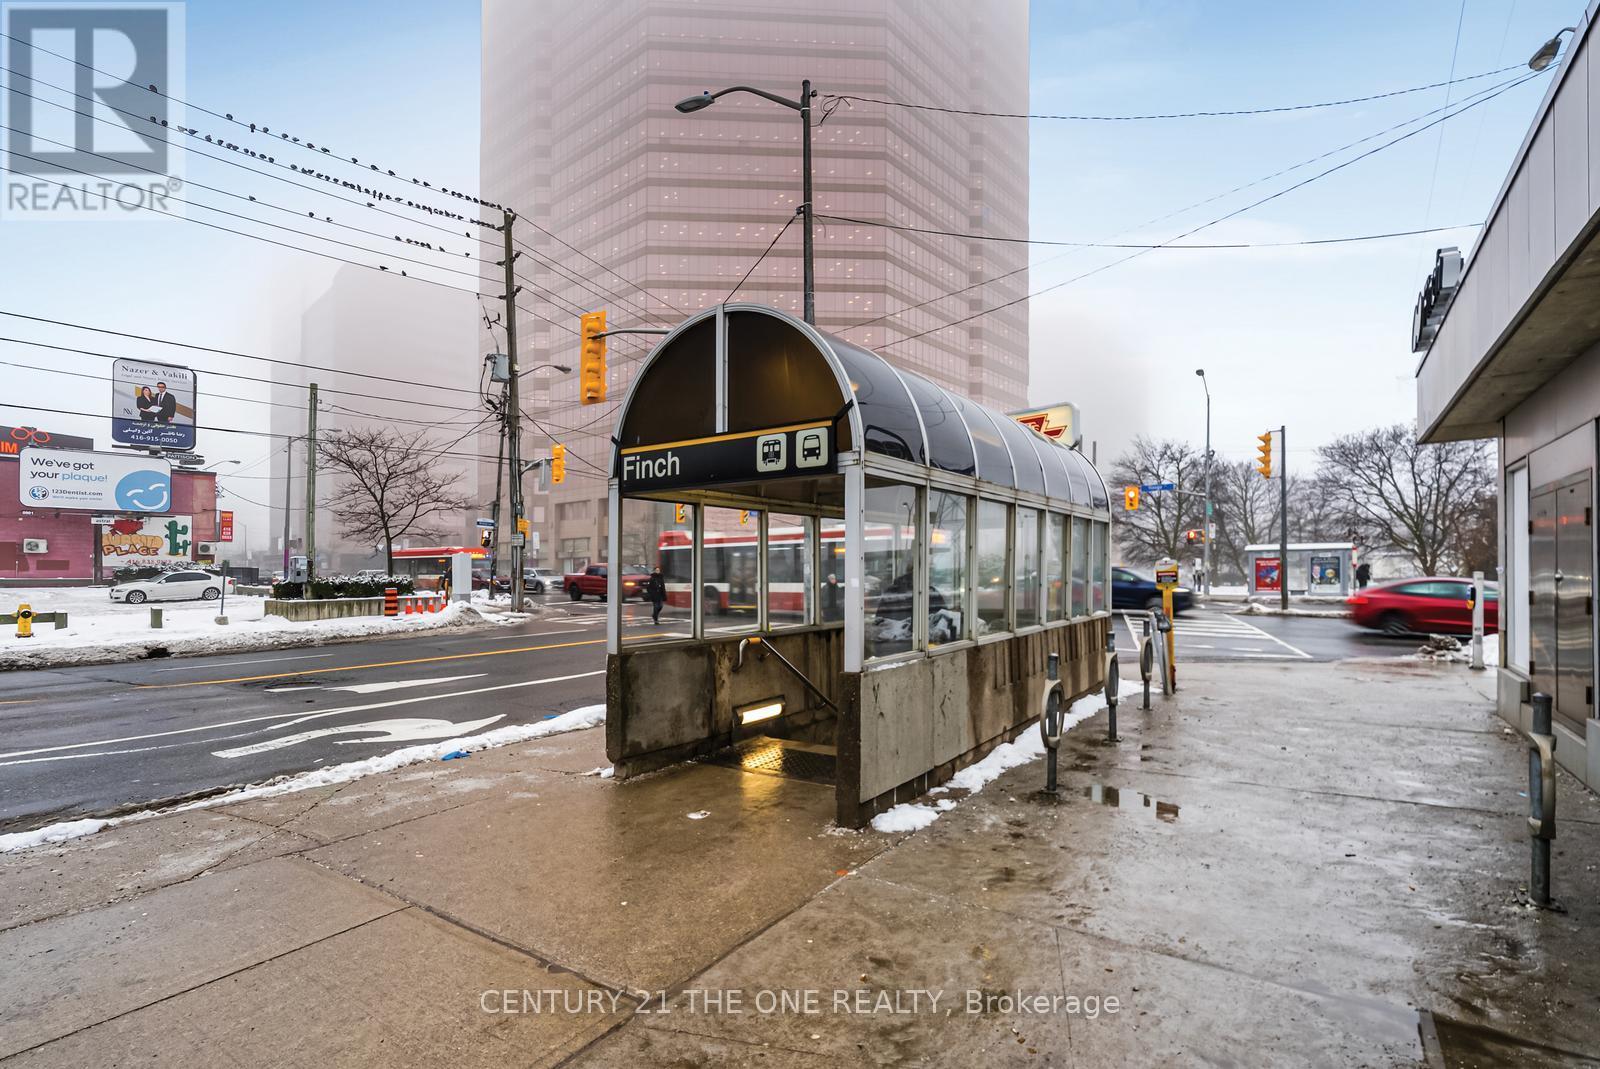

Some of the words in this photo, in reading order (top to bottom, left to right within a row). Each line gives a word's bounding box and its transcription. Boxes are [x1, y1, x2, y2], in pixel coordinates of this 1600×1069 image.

[121, 365, 150, 375] Nazer
[162, 370, 188, 380] Vakili
[131, 434, 178, 444] 416-915-0050
[31, 457, 71, 468] We've
[73, 462, 94, 471] got
[623, 451, 680, 481] Finch
[30, 471, 60, 479] your
[62, 473, 108, 483] plaque!
[52, 488, 103, 496] 123Dentist.com
[103, 543, 159, 556] PLACE
